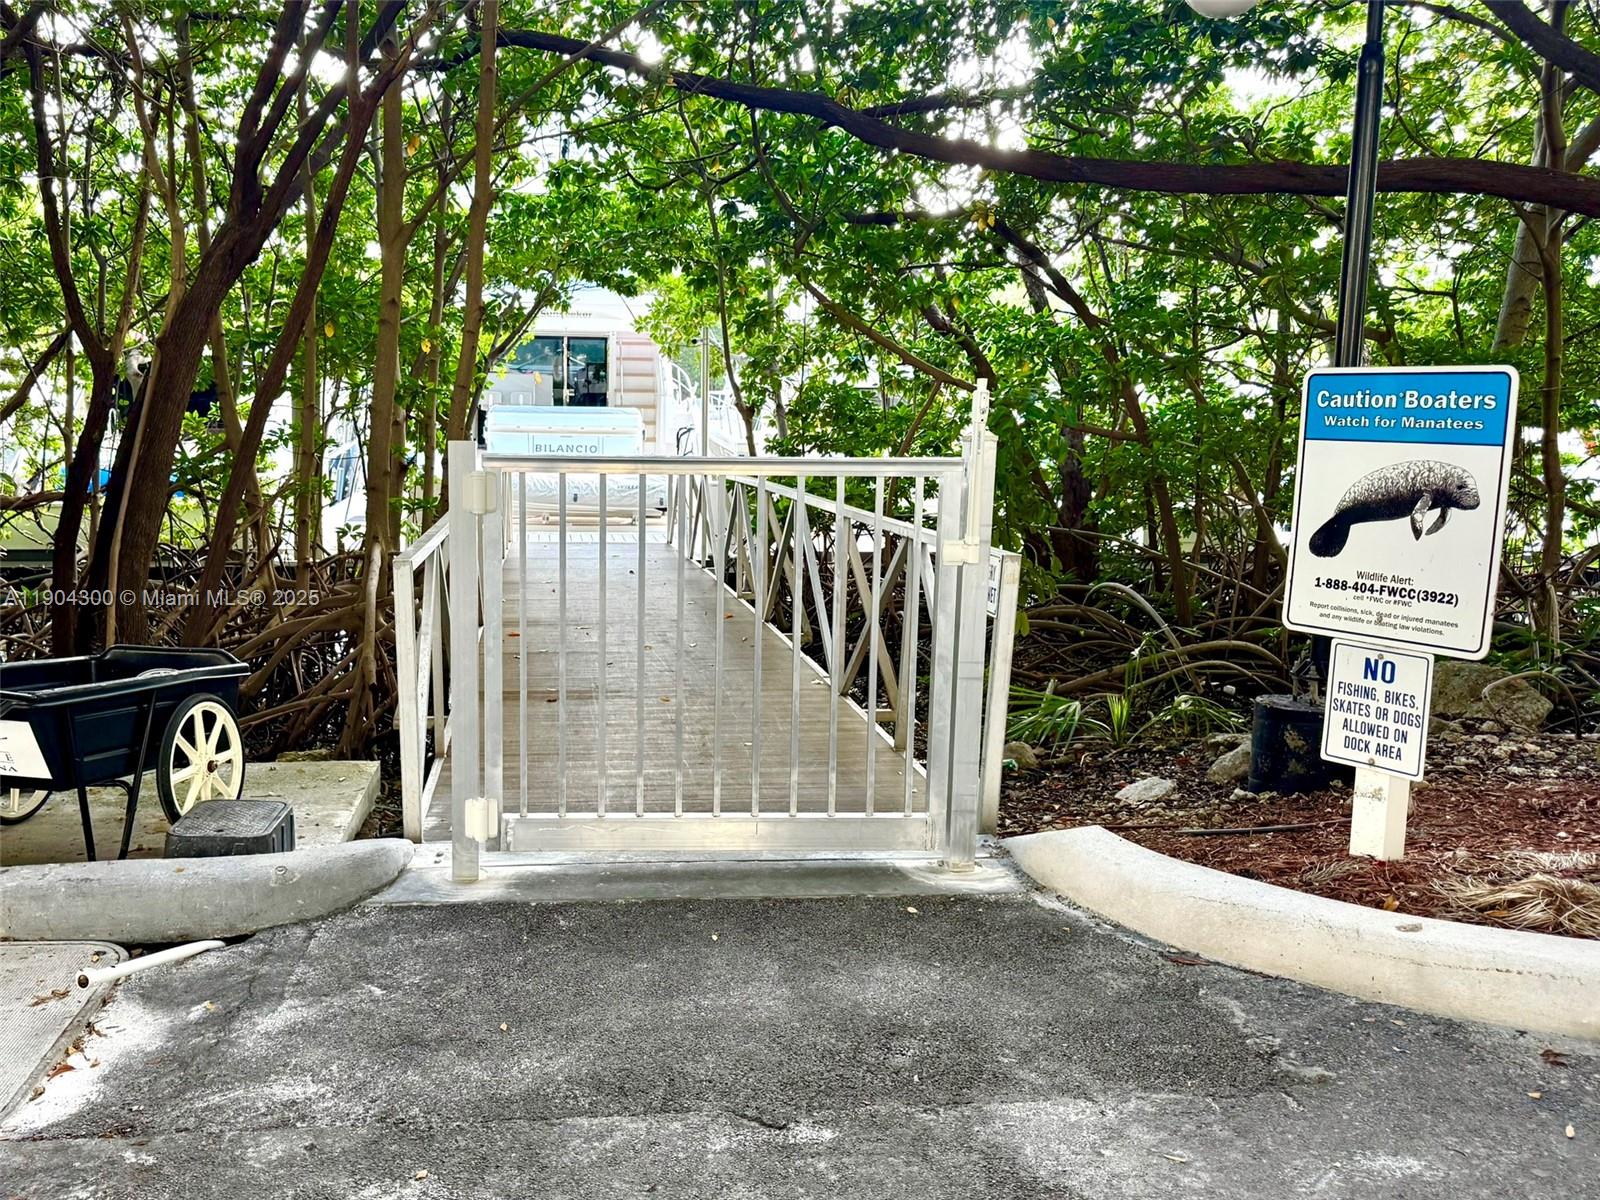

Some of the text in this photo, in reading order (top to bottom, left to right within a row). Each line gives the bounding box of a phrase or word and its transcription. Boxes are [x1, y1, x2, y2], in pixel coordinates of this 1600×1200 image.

[1316, 390, 1497, 410] Caution Boaters
[1324, 415, 1484, 430] Watch for Manatees
[535, 444, 598, 453] BILANCIO
[1356, 570, 1414, 586] Wildlife Alert:
[1314, 577, 1459, 608] 1-888-404-FWCC(3922)
[1310, 601, 1329, 609] Report
[1401, 614, 1424, 623] injured
[1425, 618, 1459, 628] manatees
[1344, 615, 1365, 623] wildlife
[1399, 623, 1410, 631] law
[1363, 657, 1396, 684] NO
[1333, 698, 1421, 728] SKATES OR DOGS
[1342, 718, 1408, 744] ALLOWED ON
[1344, 736, 1402, 760] DOCK AREA
